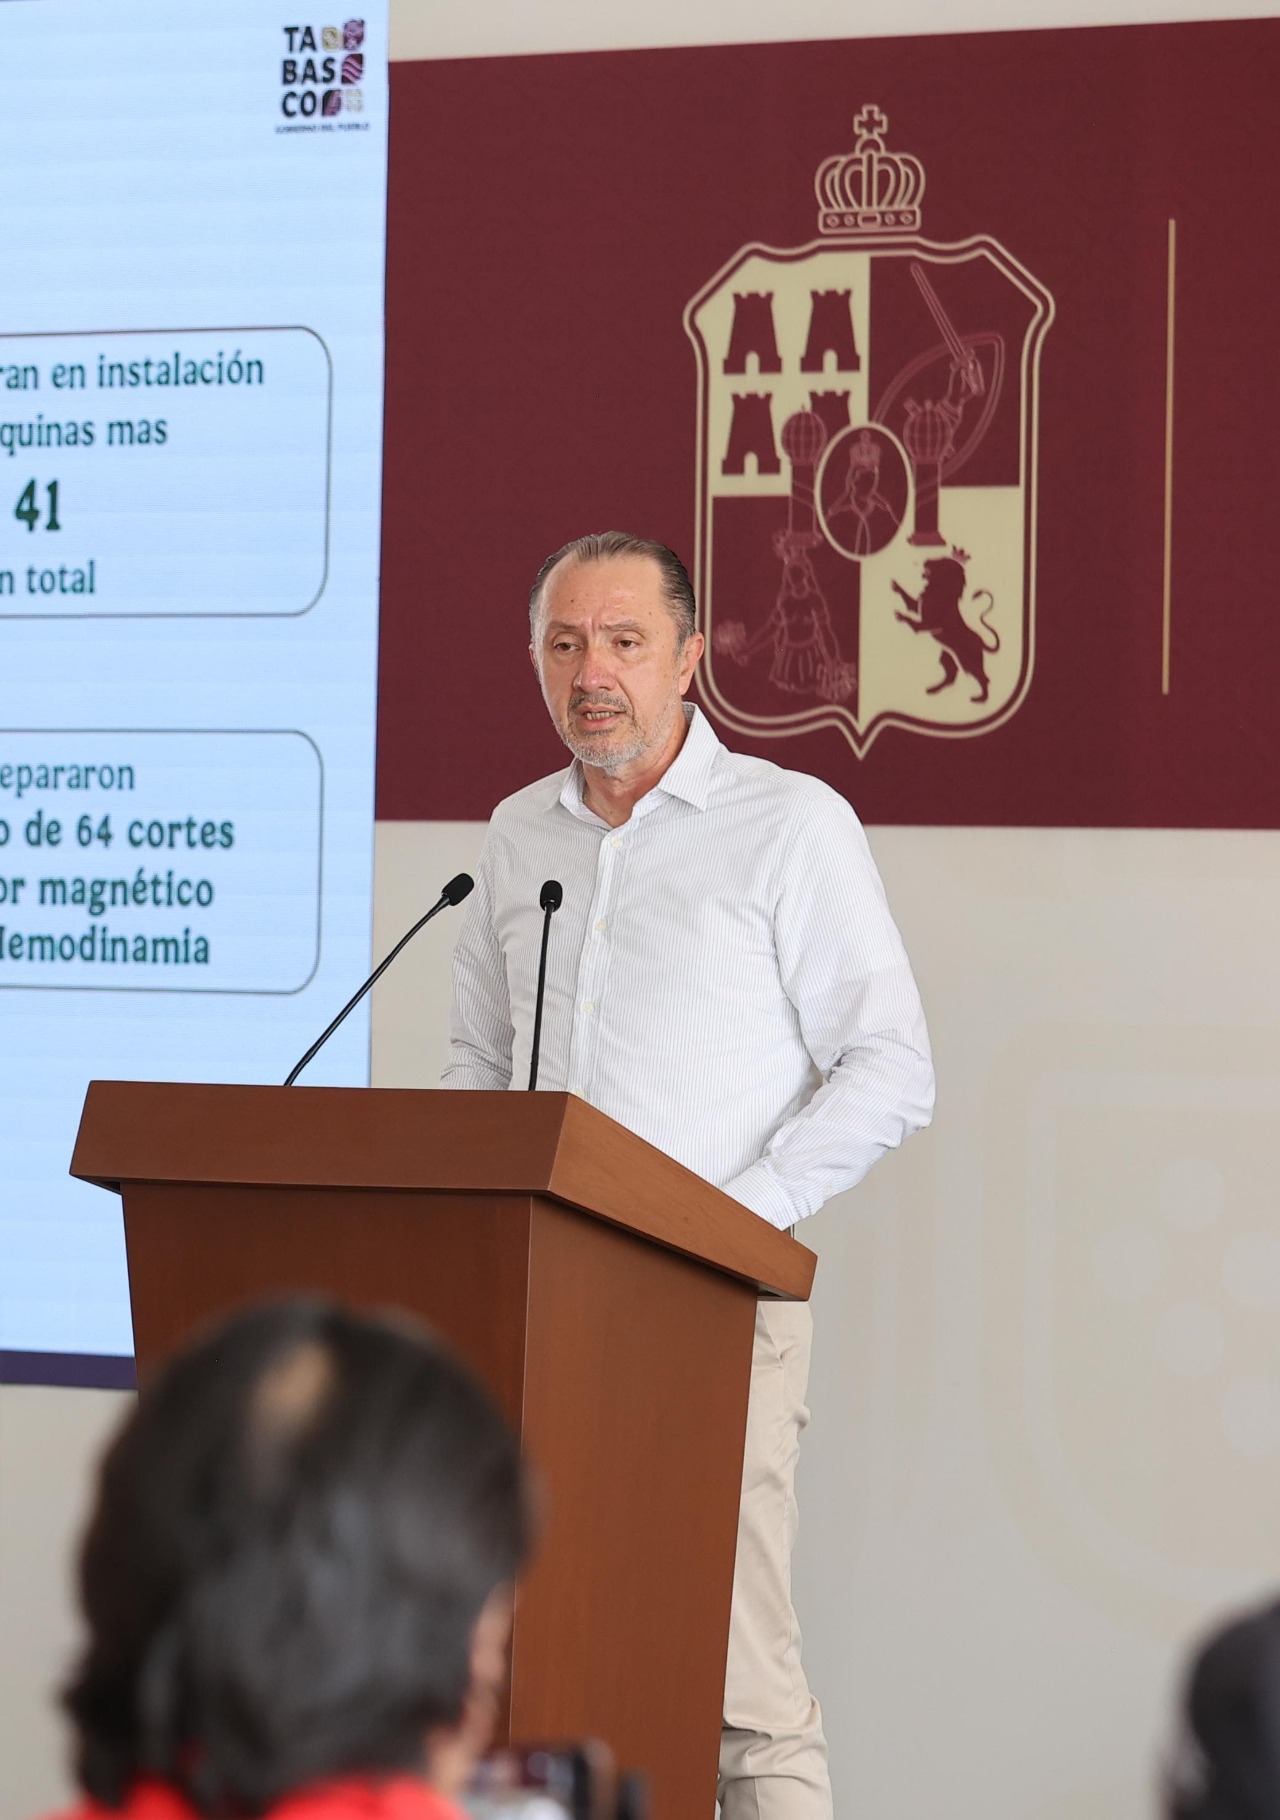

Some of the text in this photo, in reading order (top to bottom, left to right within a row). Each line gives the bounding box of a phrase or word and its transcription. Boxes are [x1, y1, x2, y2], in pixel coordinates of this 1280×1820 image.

[52, 364, 85, 389] en
[98, 350, 263, 387] instalación
[108, 420, 167, 445] mas
[14, 479, 60, 532] 41
[27, 560, 94, 594] total
[25, 810, 61, 847] de
[77, 815, 112, 847] 64
[128, 817, 234, 849] cortes
[40, 868, 213, 917] magnético
